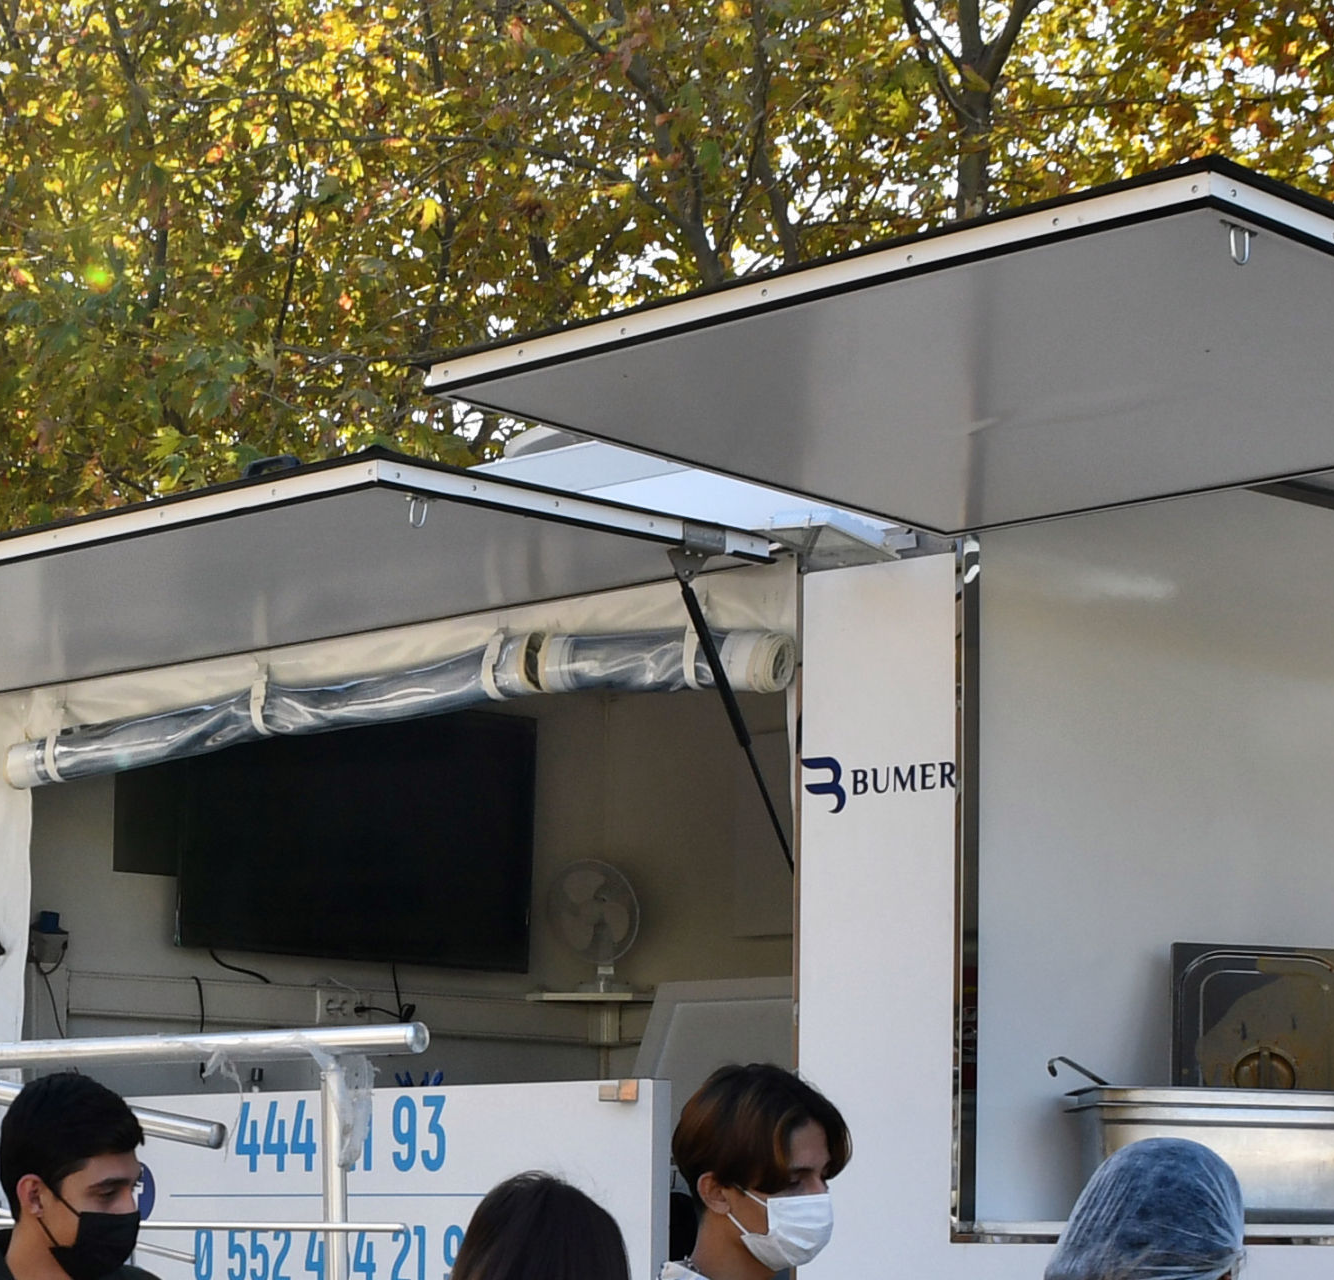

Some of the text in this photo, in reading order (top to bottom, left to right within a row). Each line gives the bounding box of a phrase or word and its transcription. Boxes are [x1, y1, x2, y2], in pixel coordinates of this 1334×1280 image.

[851, 762, 956, 795] BUMER
[235, 1100, 317, 1173] 444
[392, 1095, 446, 1172] 93
